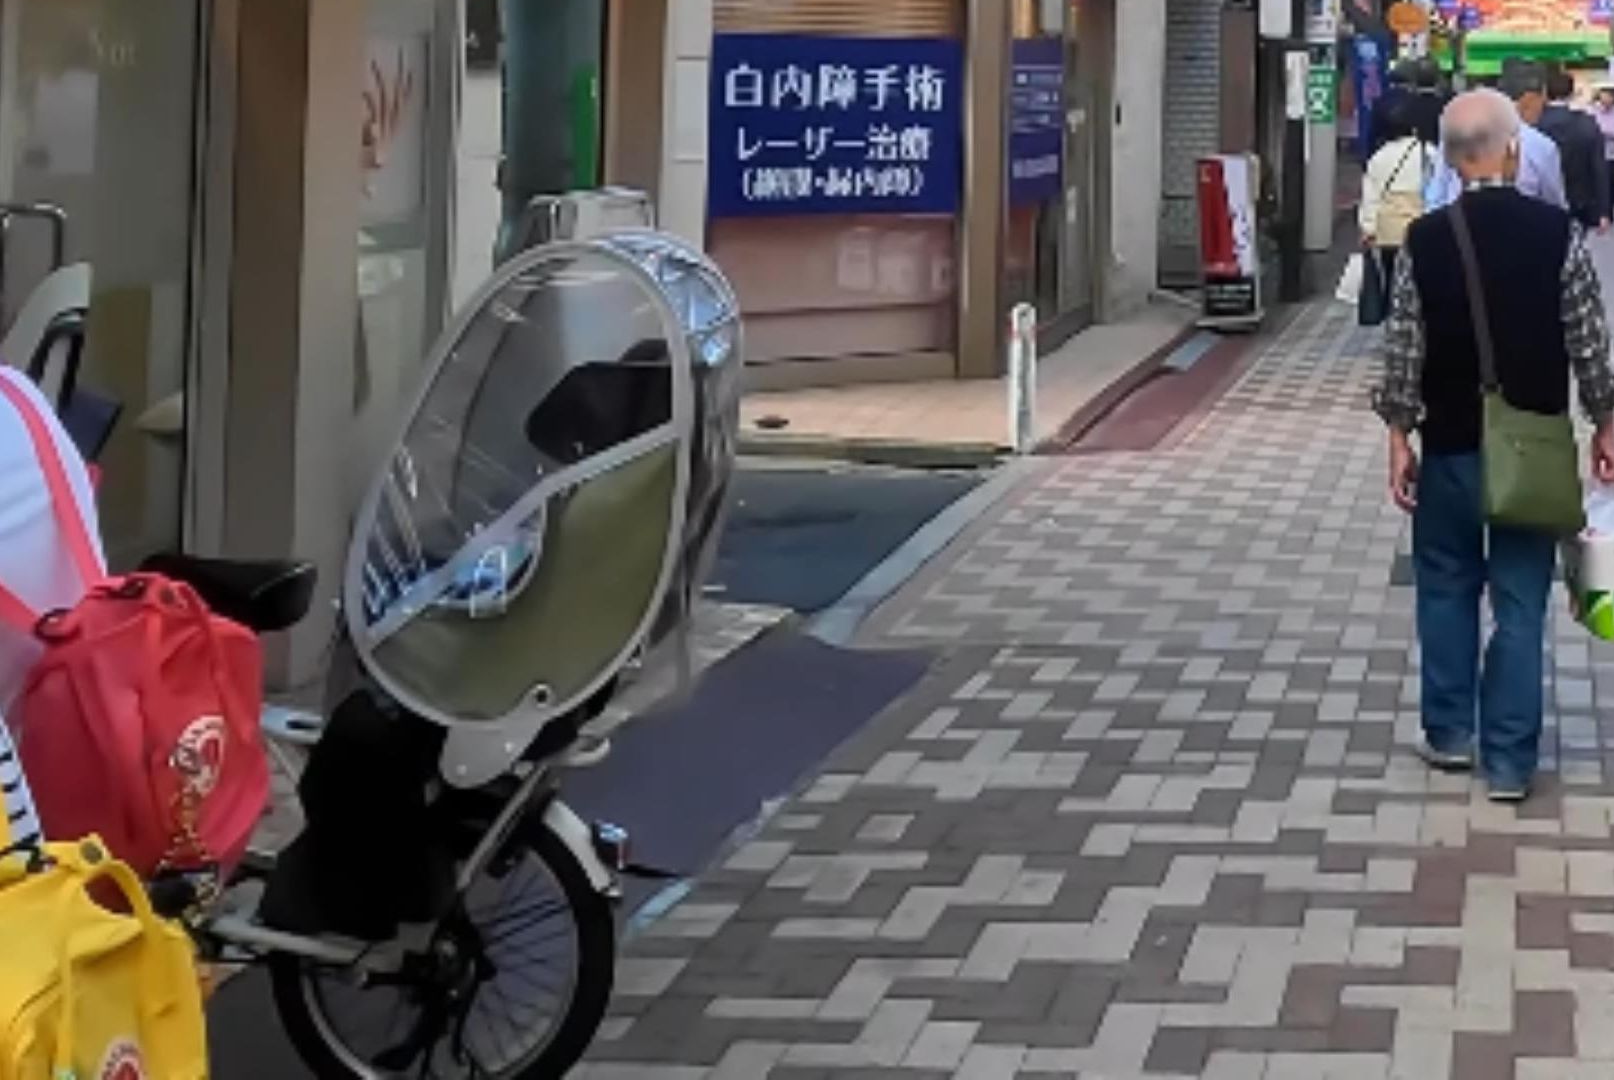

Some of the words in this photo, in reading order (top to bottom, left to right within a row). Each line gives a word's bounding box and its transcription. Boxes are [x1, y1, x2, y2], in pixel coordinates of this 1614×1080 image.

[724, 62, 945, 111] 白内障手術
[737, 124, 932, 161] レーザー治療
